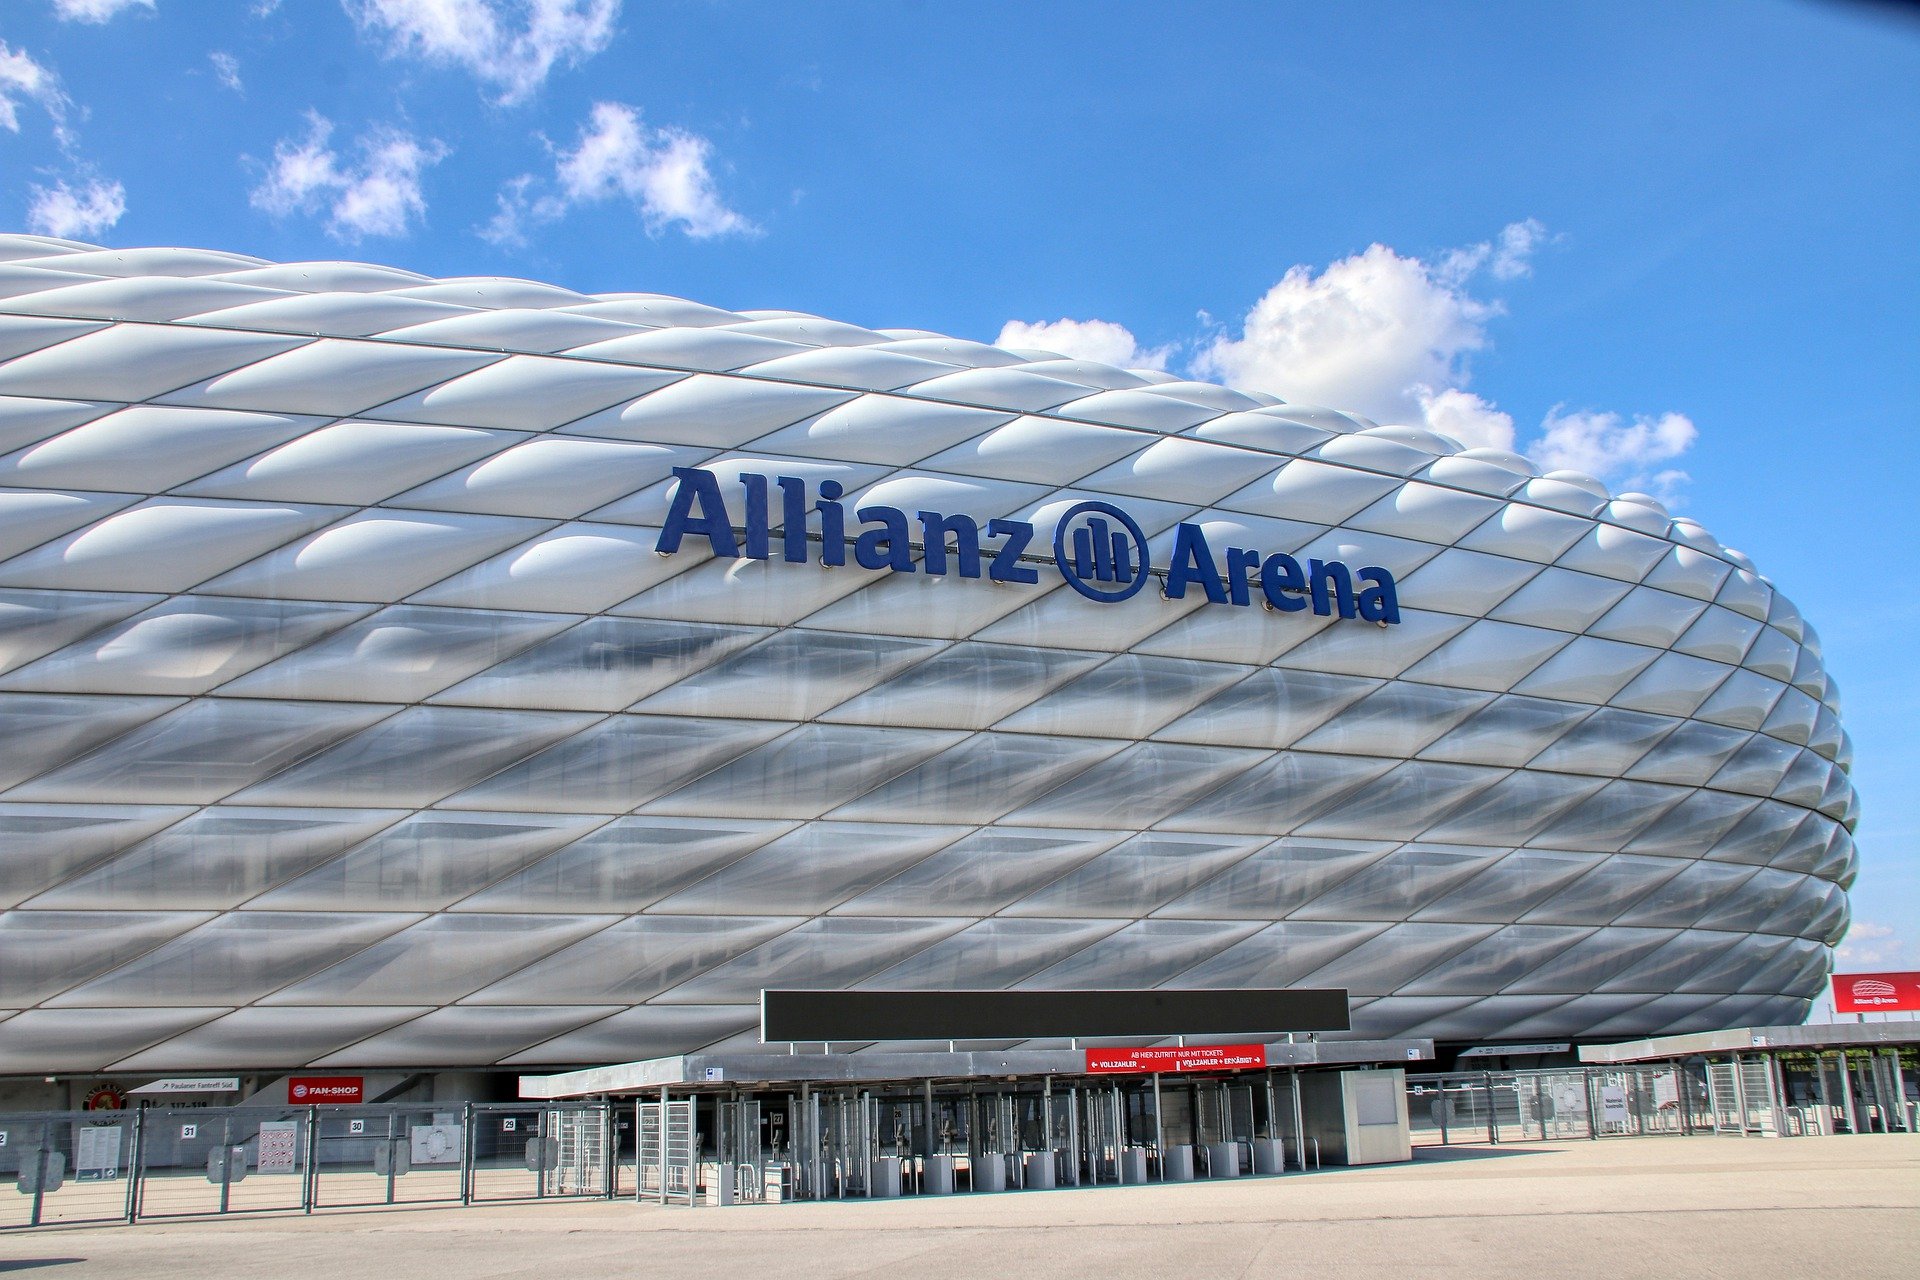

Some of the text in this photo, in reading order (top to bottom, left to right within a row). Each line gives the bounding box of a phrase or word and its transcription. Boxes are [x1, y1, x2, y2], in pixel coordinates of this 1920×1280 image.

[655, 466, 1402, 625] Allianz Arena
[1201, 1049, 1223, 1057] TICKETS
[1182, 1058, 1218, 1066] VOLLZAHLER
[197, 1081, 221, 1089] Fantreff
[309, 1086, 358, 1095] FAN-SHOP
[774, 1115, 782, 1123] 27
[352, 1122, 362, 1131] 30
[505, 1120, 514, 1129] 29
[184, 1127, 194, 1136] 31
